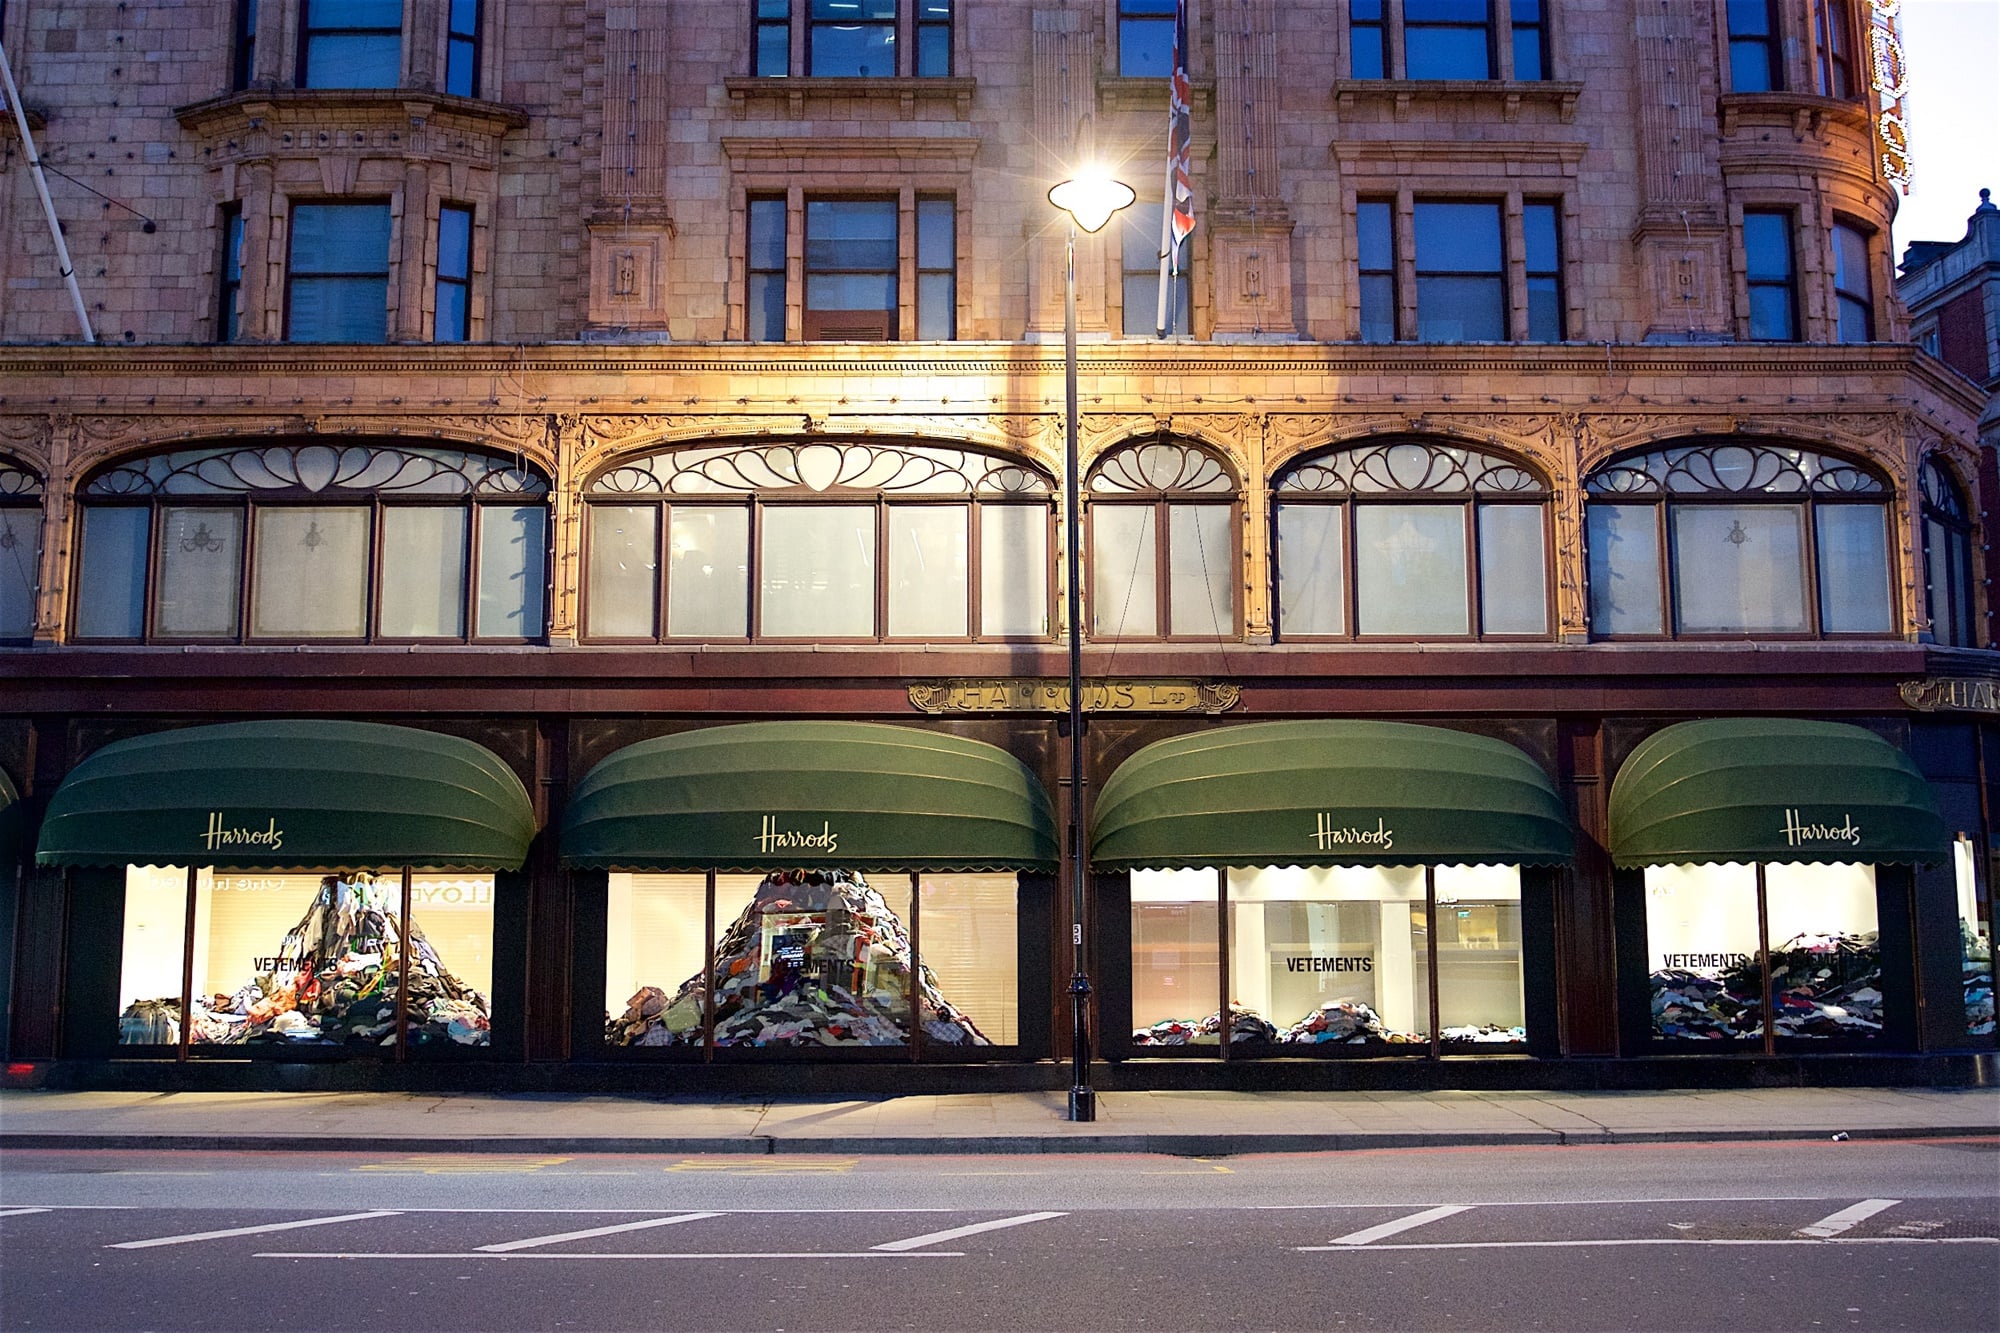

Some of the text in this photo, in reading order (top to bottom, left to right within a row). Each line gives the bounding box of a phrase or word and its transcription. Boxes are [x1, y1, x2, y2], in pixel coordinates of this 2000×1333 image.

[200, 812, 284, 850] Harrods
[753, 815, 838, 853] Harrods
[1309, 812, 1393, 850] Harrods
[1779, 808, 1861, 846] Harrods
[254, 957, 338, 972] VETEMENTS
[1286, 957, 1372, 972] VETEMENTS
[1663, 953, 1746, 968] VETEMENTS
